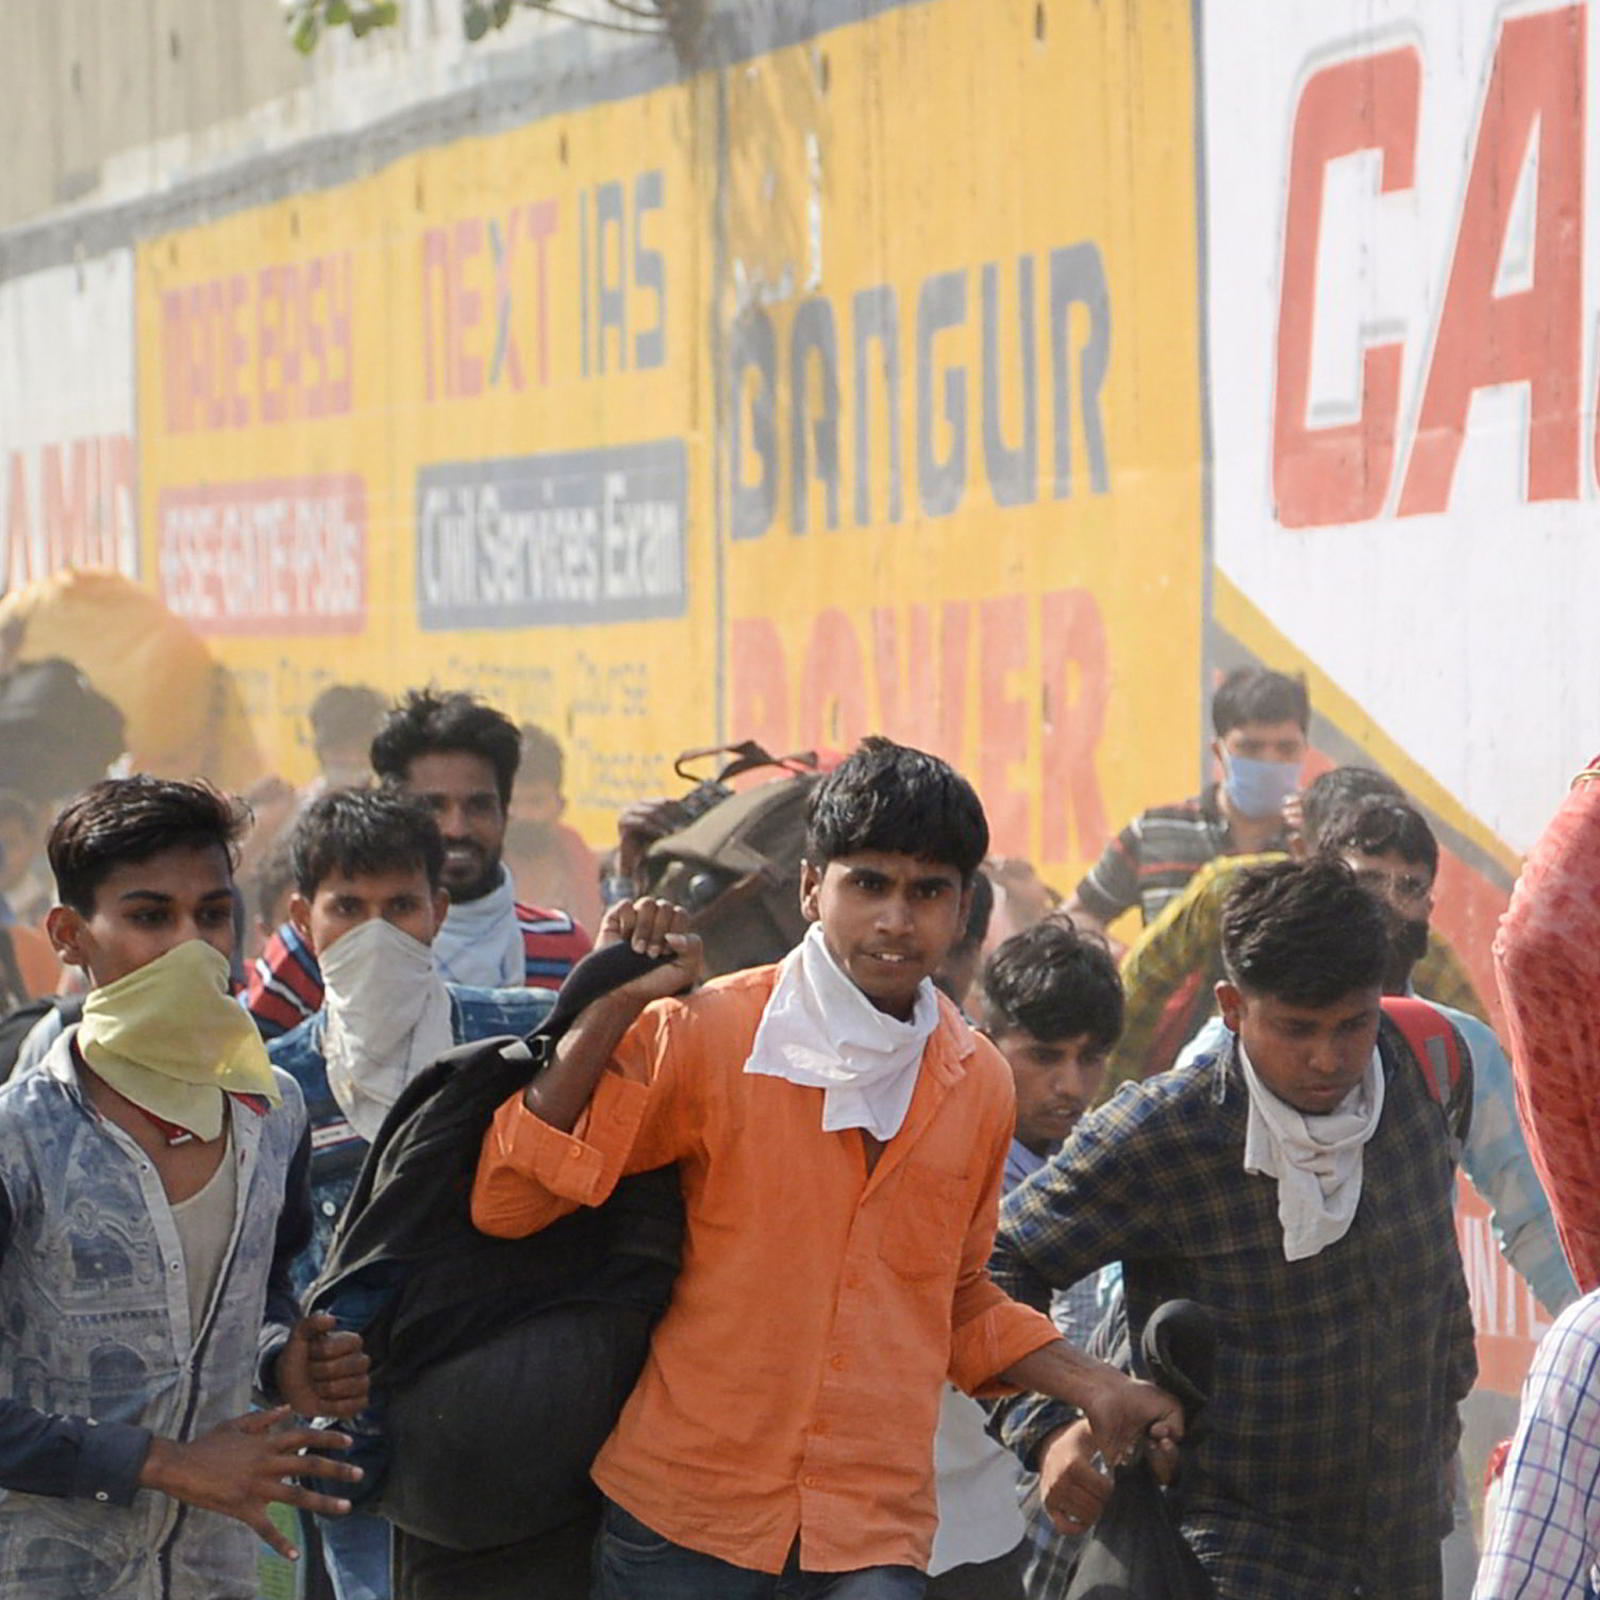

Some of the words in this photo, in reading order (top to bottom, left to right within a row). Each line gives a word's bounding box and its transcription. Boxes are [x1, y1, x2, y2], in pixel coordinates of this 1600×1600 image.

[423, 199, 559, 402] NEXT
[580, 169, 664, 379] IAS
[729, 240, 1112, 541] BANGUR
[423, 487, 473, 605] Civil
[477, 477, 598, 606] Services
[605, 470, 684, 598] Exam
